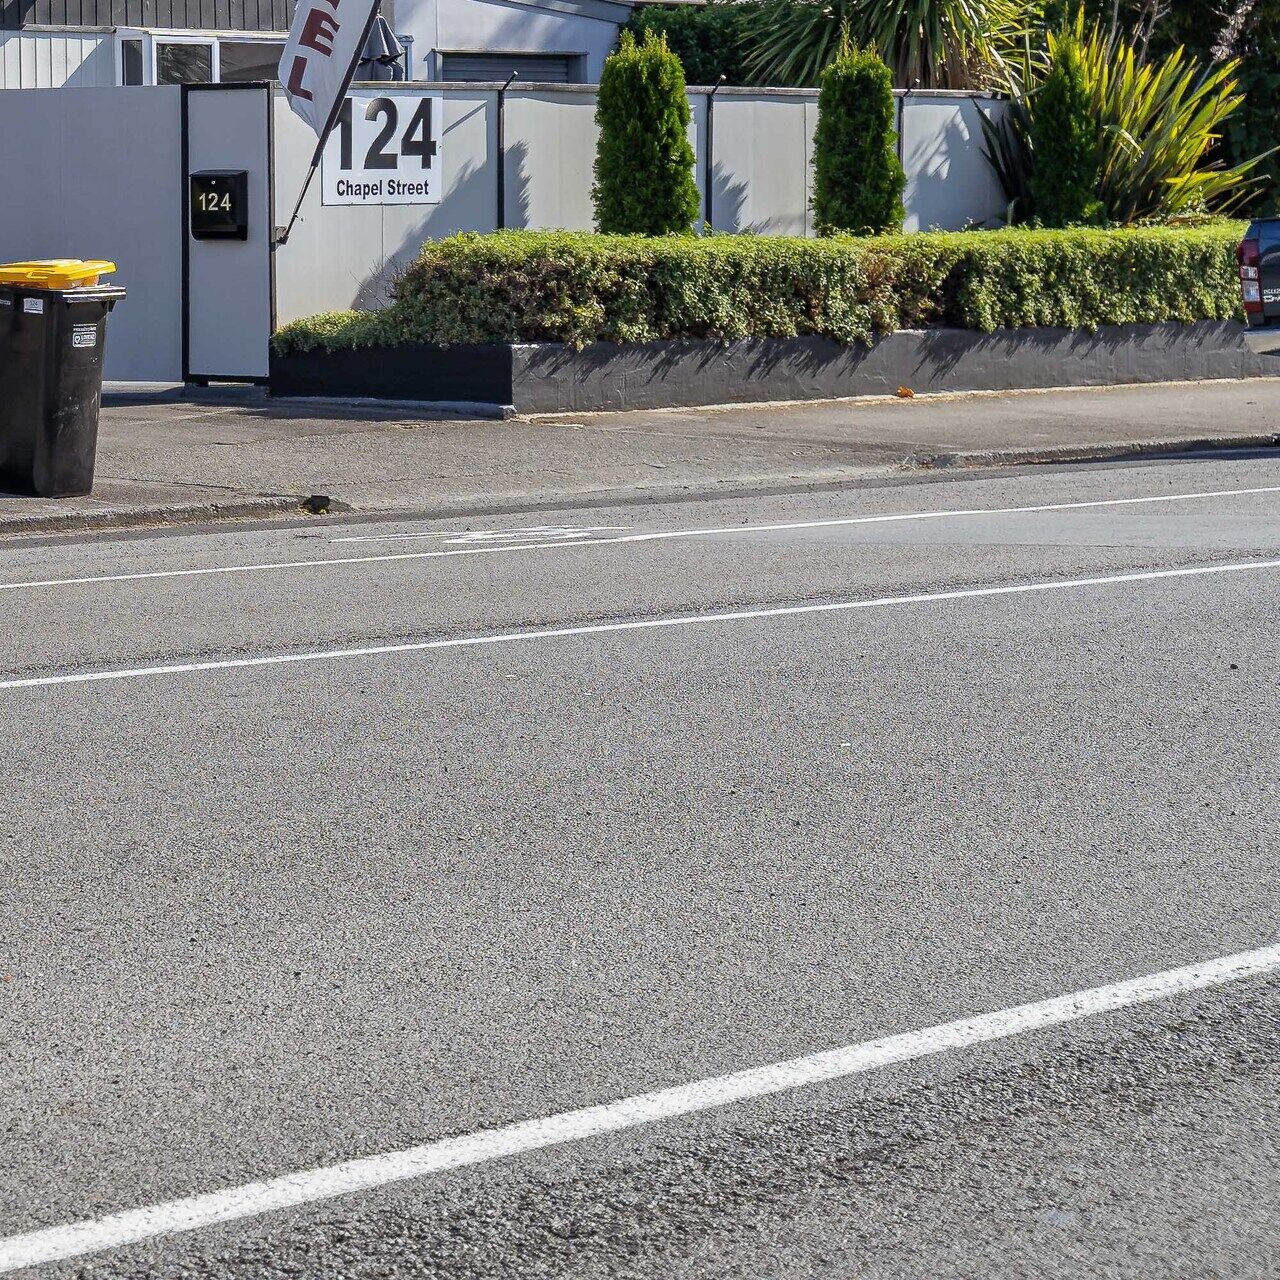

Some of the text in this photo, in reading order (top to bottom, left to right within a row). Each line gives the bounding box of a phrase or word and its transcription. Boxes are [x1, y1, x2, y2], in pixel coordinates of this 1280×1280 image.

[334, 97, 437, 171] 124
[337, 179, 429, 200] Chapel Street
[199, 192, 231, 212] 124
